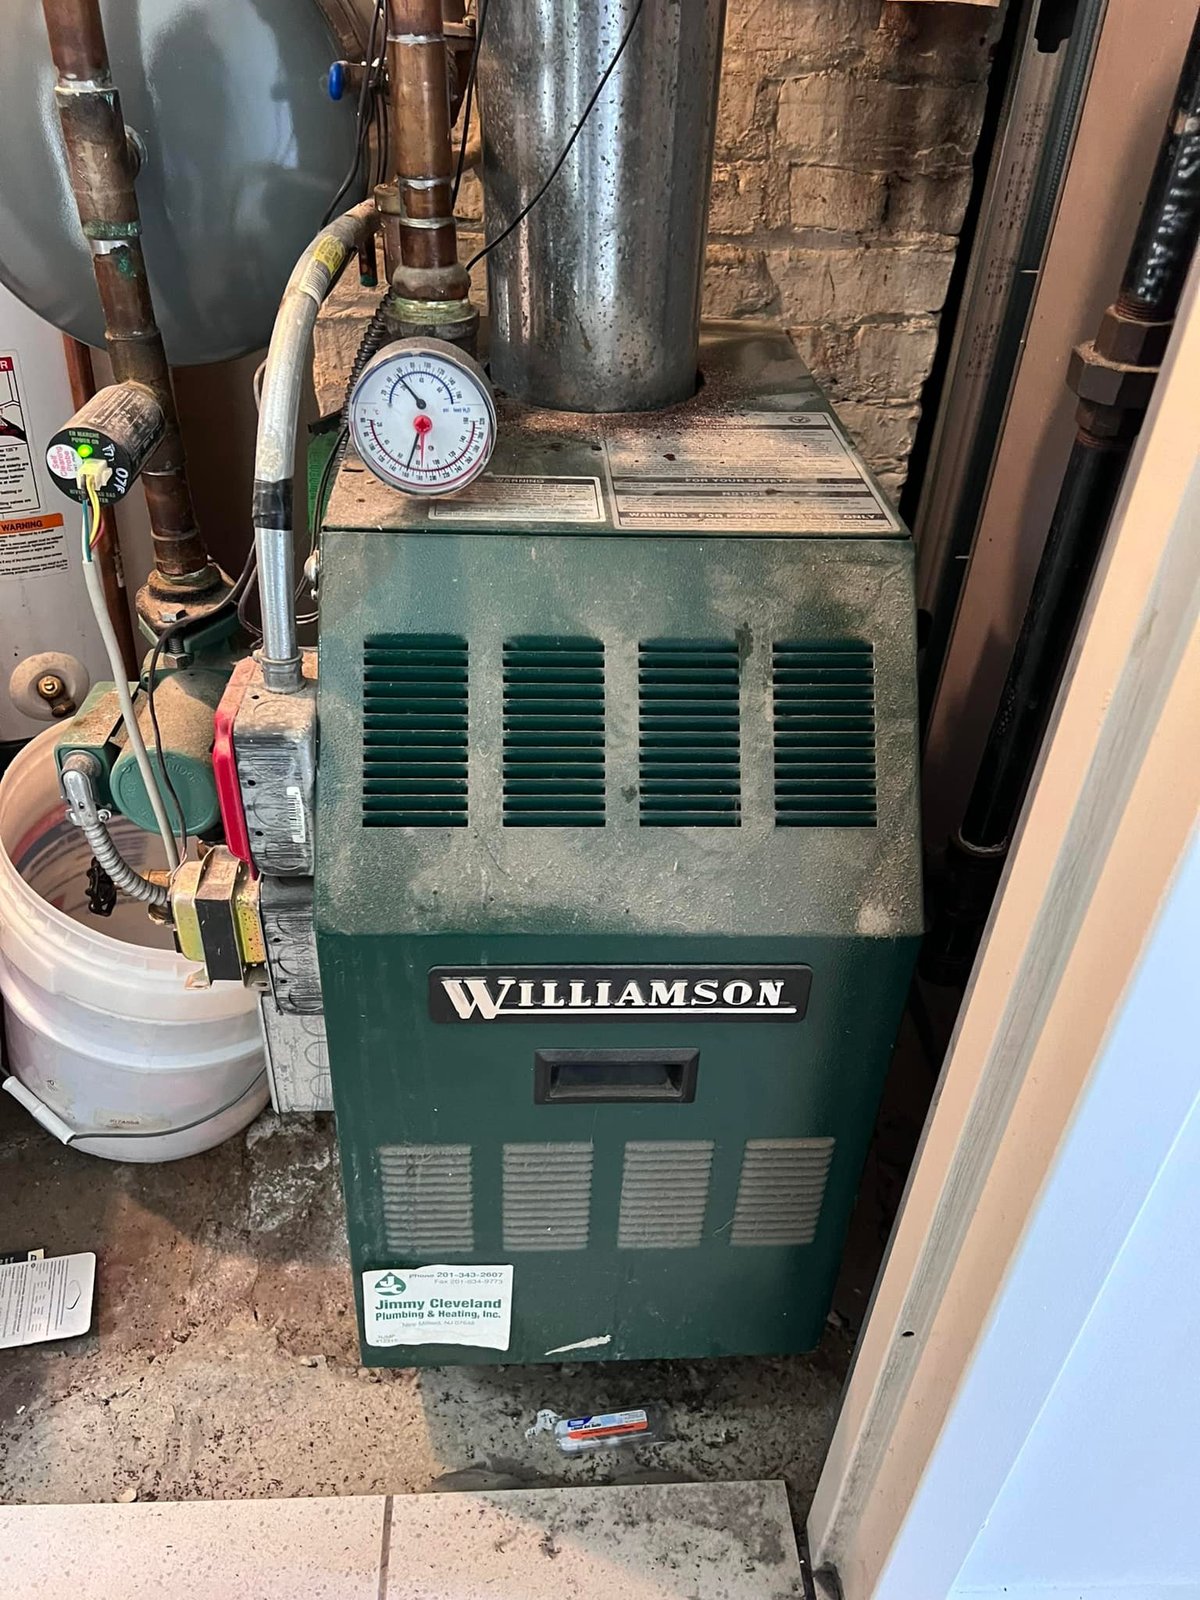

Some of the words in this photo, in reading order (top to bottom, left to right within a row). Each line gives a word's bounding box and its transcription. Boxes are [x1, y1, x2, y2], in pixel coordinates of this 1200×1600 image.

[2, 520, 43, 531] WARNING
[440, 978, 786, 1020] WILLIAMSON
[375, 1300, 425, 1310] Jimmy
[430, 1298, 501, 1308] Cleveland
[376, 1311, 424, 1321] Plumbing
[438, 1310, 480, 1319] Heating,
